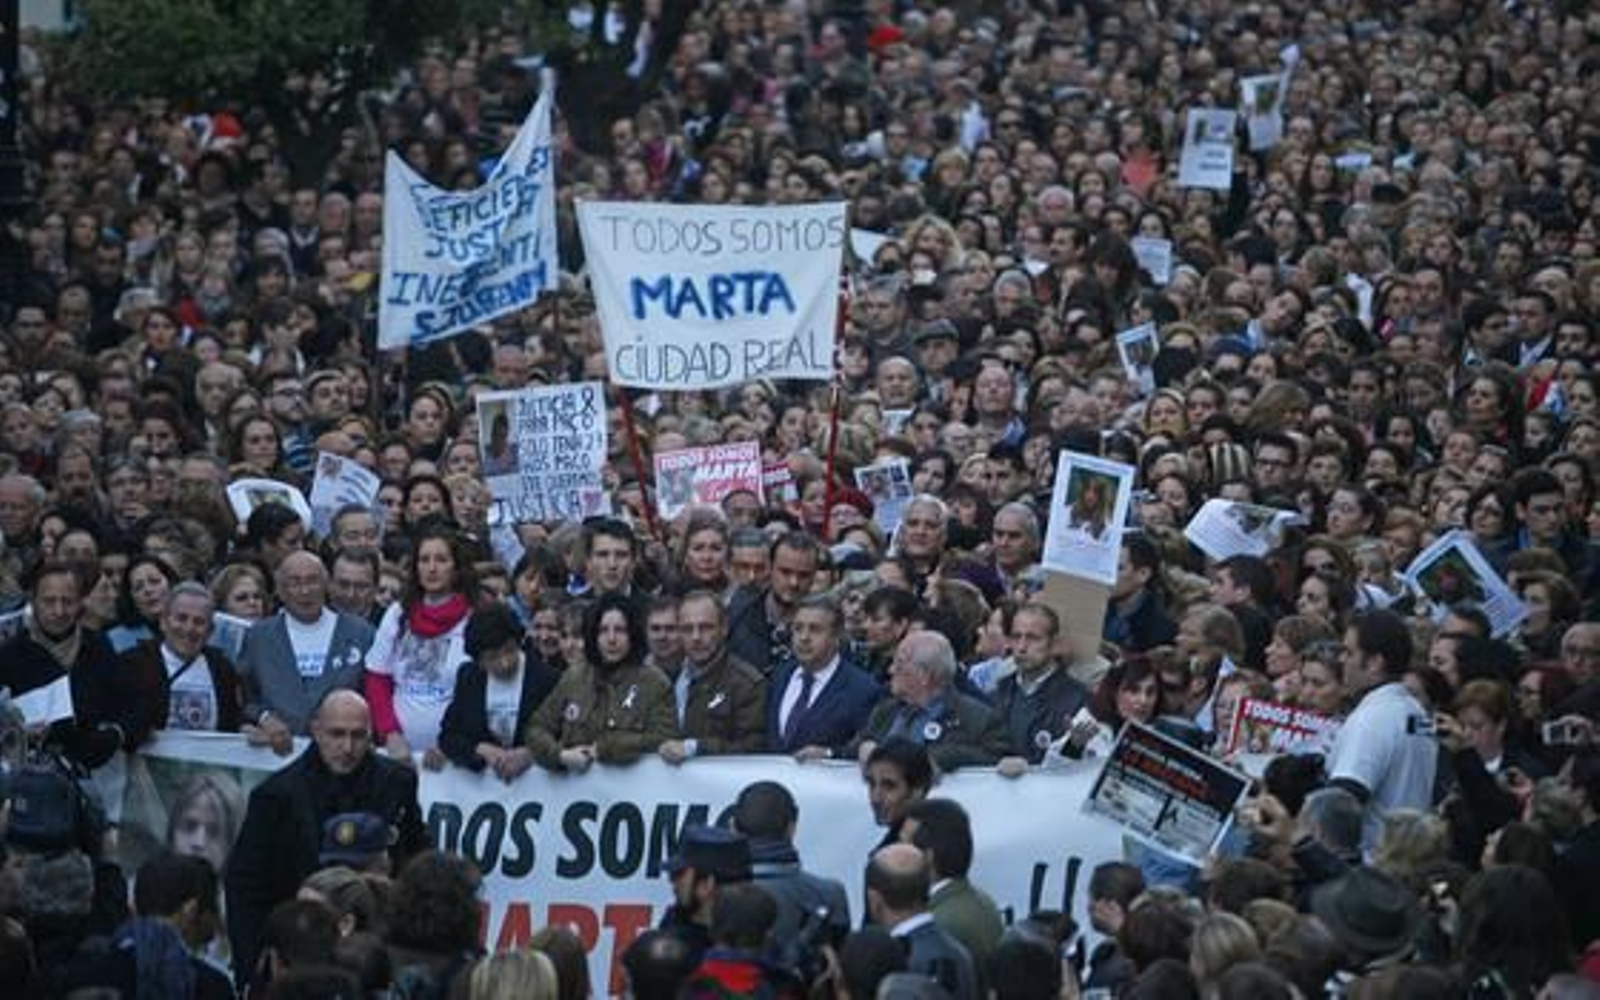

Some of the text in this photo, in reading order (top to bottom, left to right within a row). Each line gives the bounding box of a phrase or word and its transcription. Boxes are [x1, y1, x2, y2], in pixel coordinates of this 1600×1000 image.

[600, 214, 845, 255] TODOS SOMOS
[631, 271, 797, 320] MARTA
[743, 330, 828, 378] REAL
[693, 461, 758, 482] MARTA
[707, 444, 756, 462] SOMOS
[1244, 699, 1291, 724] TODOS
[556, 801, 736, 879] SOM
